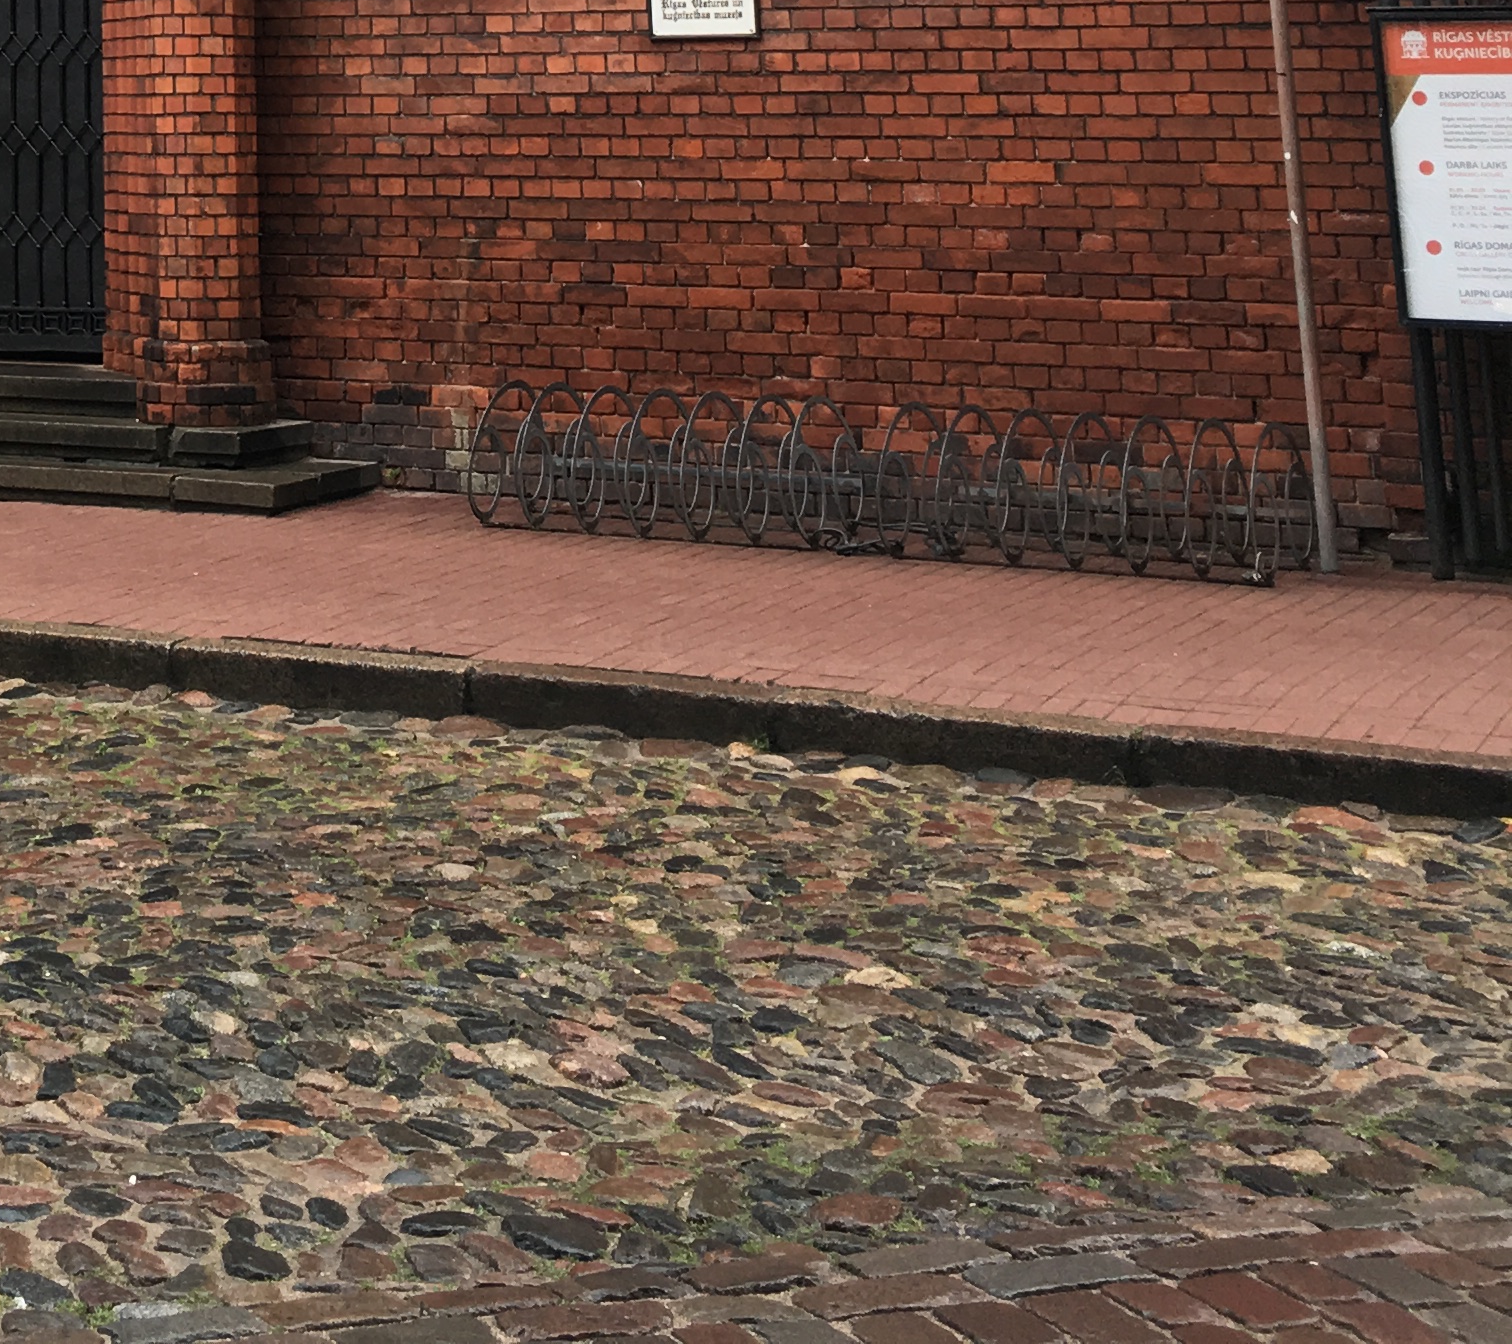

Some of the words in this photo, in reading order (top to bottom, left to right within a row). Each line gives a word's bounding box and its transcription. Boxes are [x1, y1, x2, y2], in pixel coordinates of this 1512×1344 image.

[1432, 29, 1474, 43] RĪGAS
[1445, 160, 1479, 170] DARBA
[1481, 160, 1508, 170] LAIKS
[1454, 240, 1484, 250] RĪGAS
[1458, 288, 1491, 298] LAIPNI
